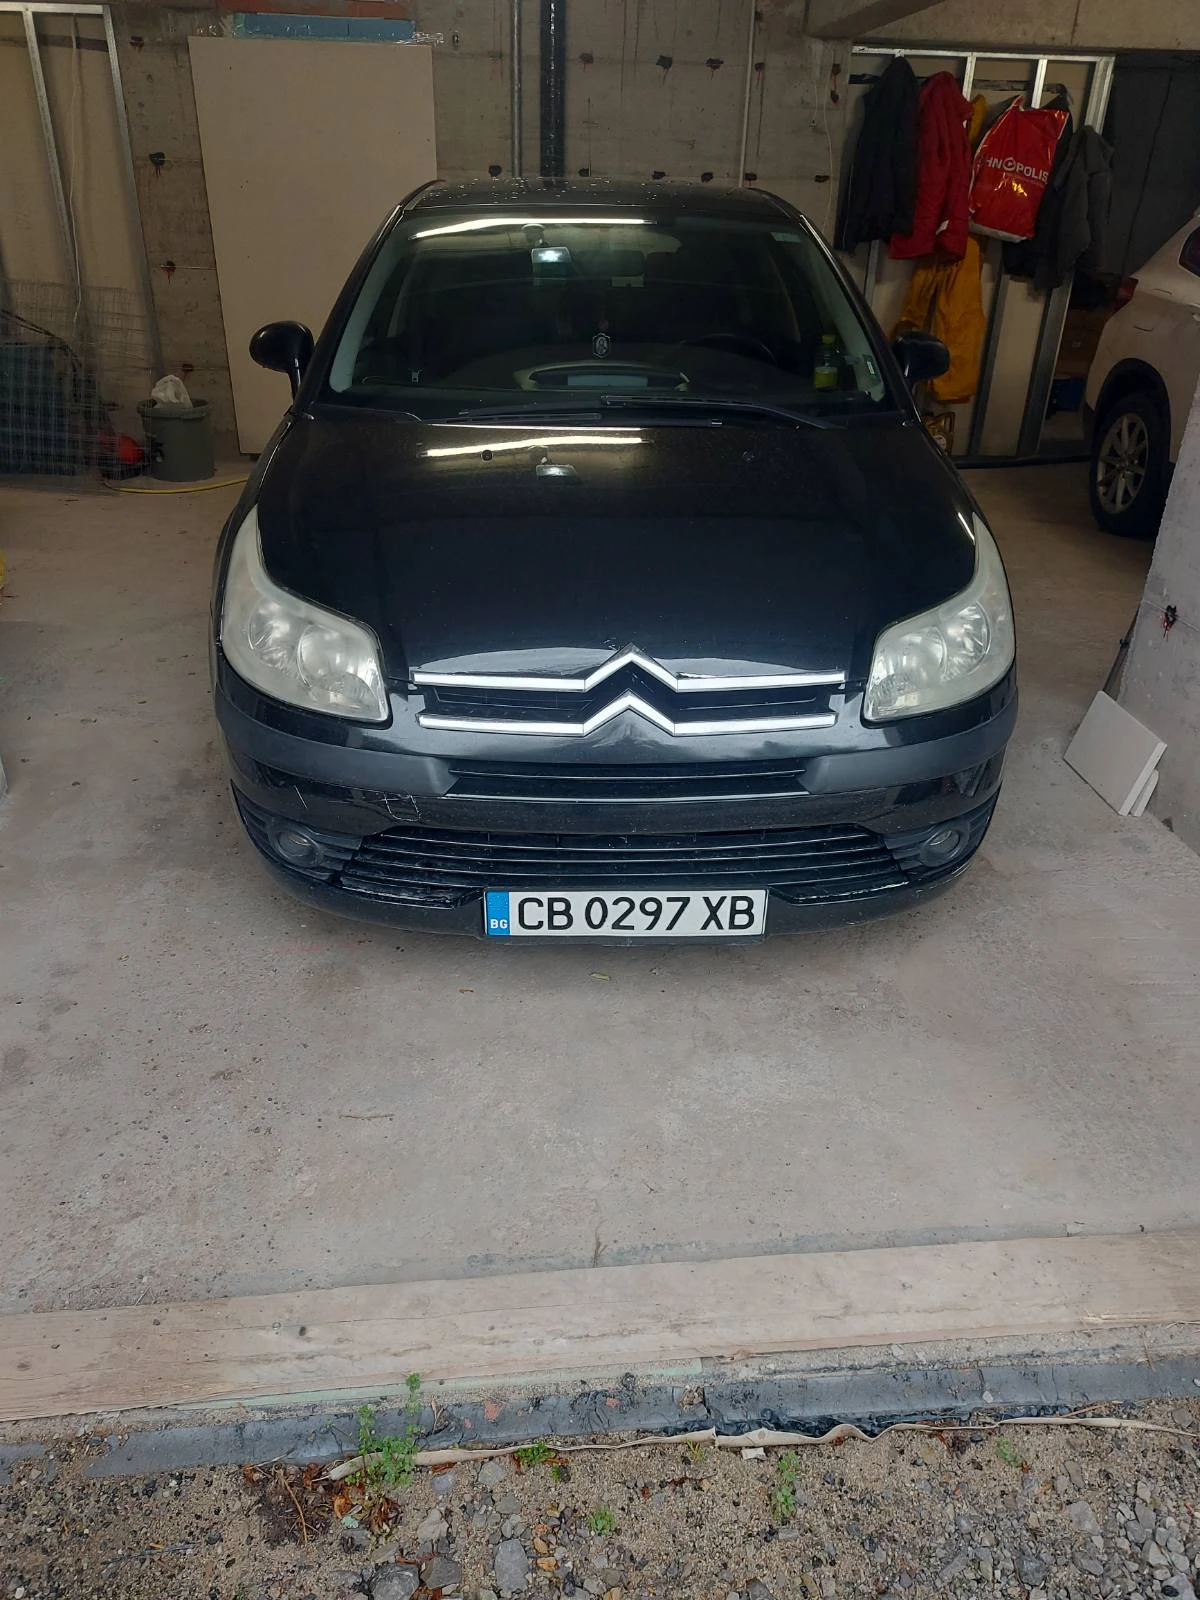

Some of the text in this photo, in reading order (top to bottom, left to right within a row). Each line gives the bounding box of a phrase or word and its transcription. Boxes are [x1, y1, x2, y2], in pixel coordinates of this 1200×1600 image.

[986, 156, 1049, 183] HNOPOLIS
[490, 919, 508, 929] BG
[518, 895, 755, 931] CB 0297 XB
